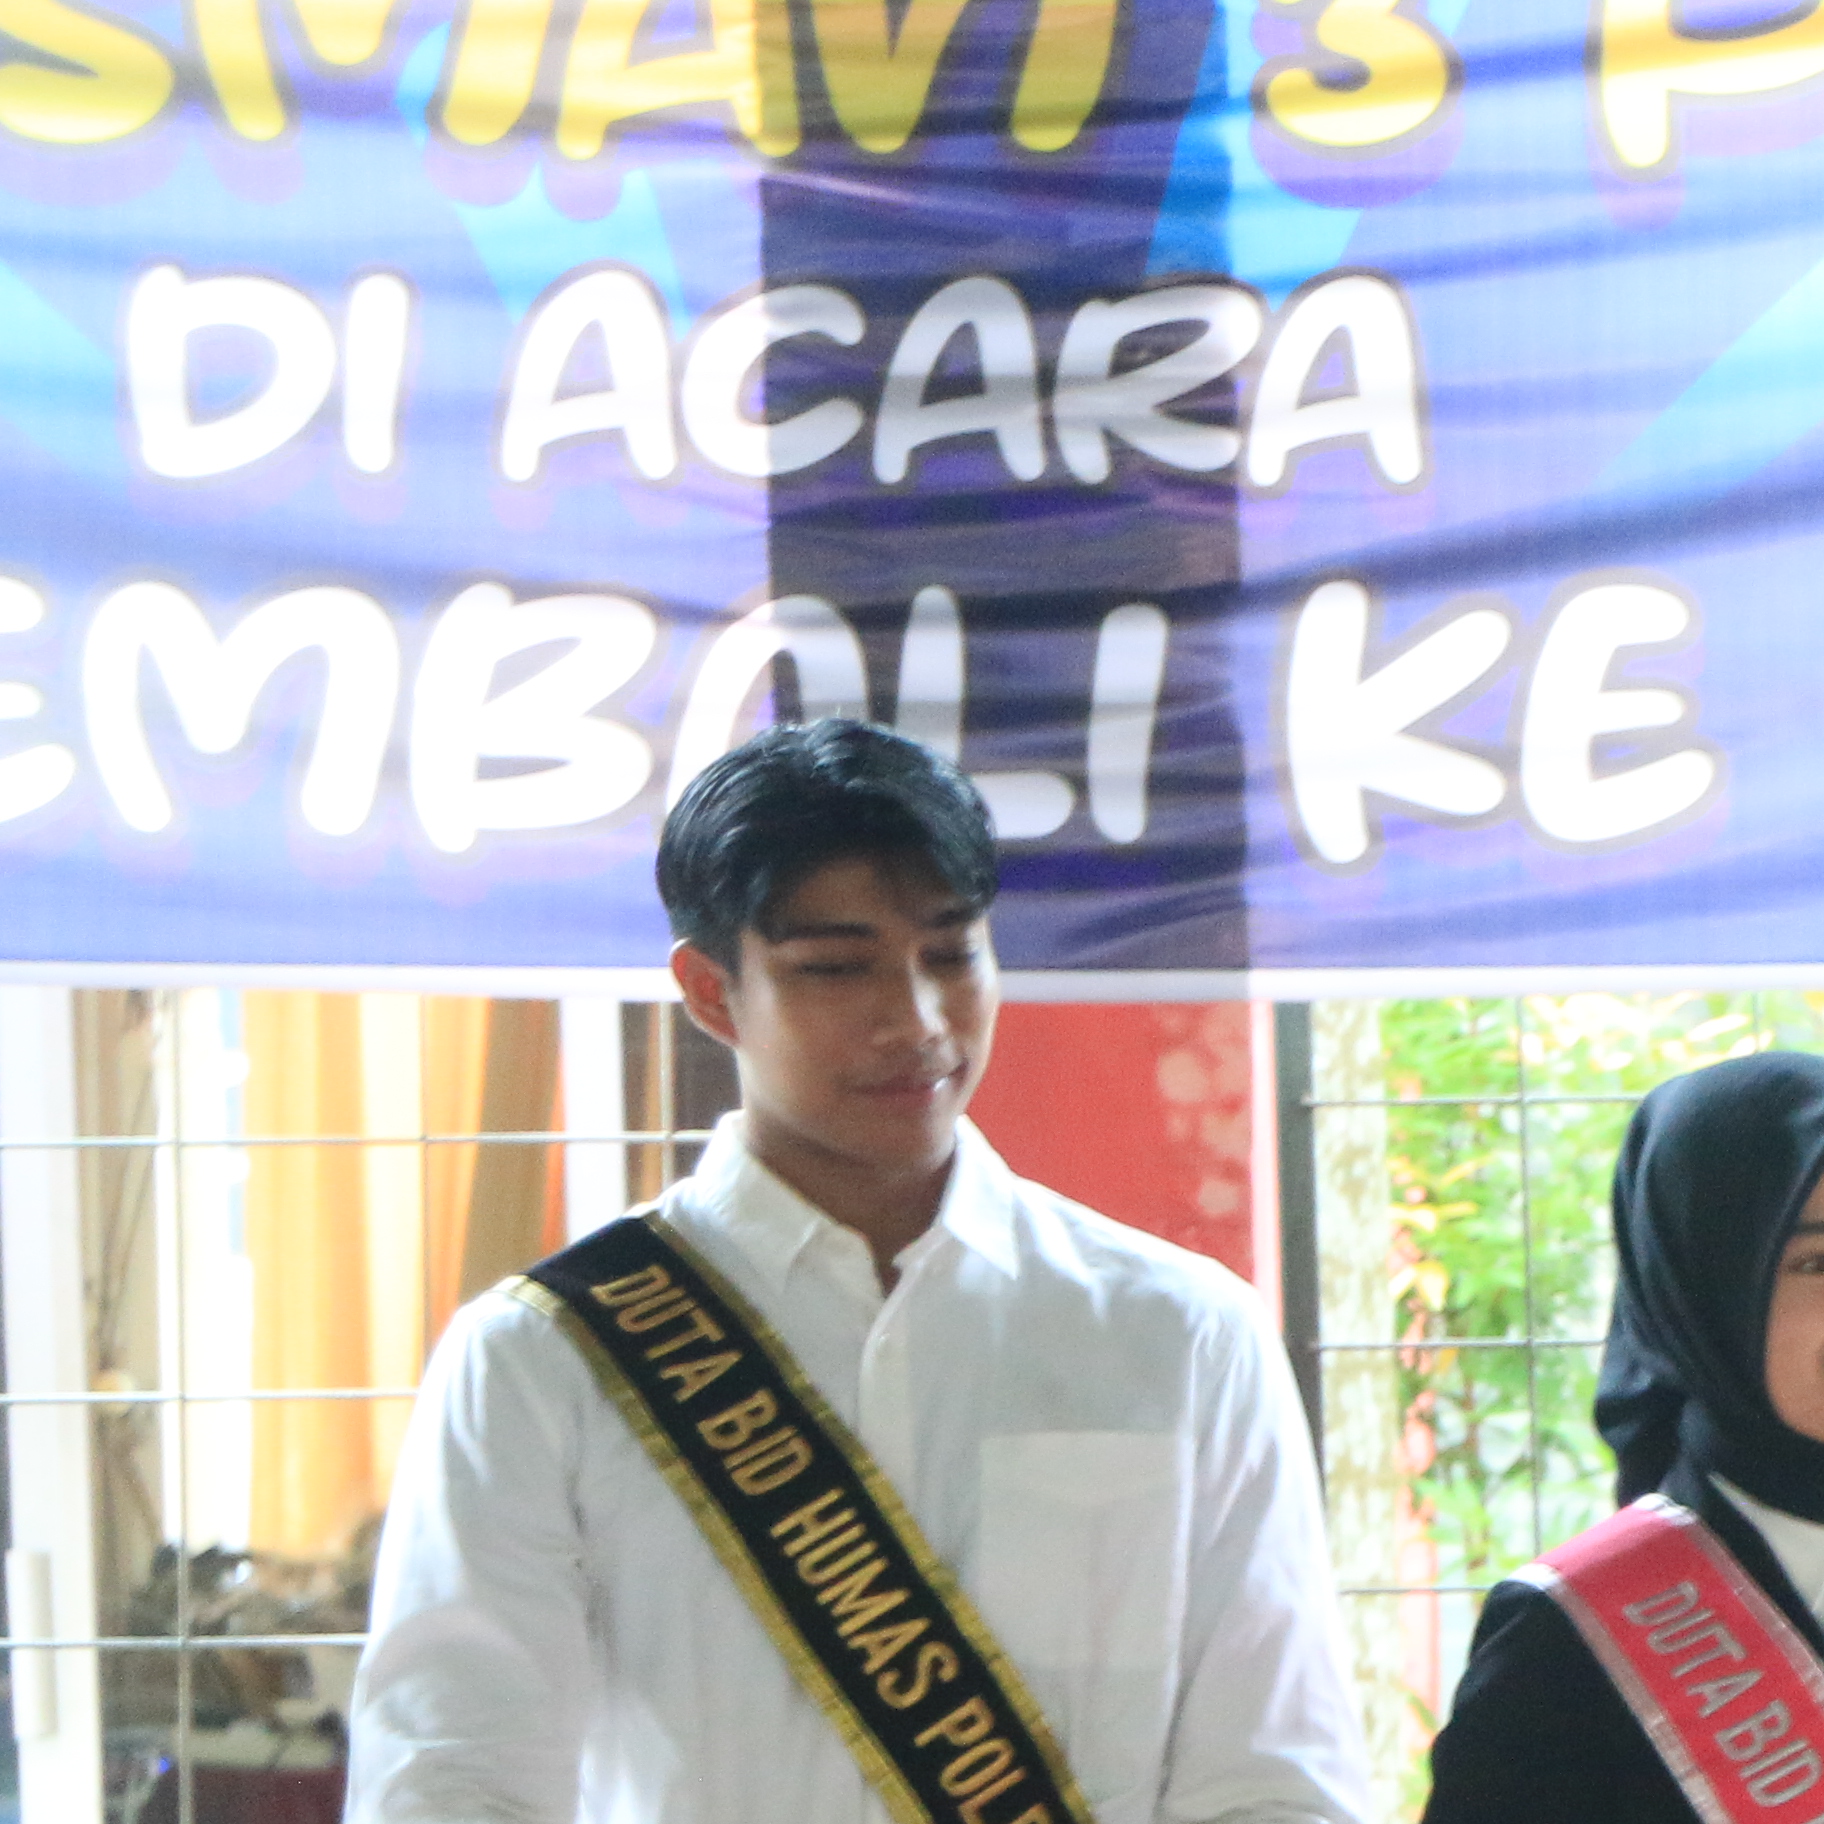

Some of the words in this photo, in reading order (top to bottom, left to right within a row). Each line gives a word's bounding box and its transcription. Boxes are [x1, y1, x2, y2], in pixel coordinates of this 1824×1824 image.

[128, 262, 410, 480] DI
[501, 263, 1427, 487] ACARA
[1289, 576, 1720, 866] KE
[592, 1262, 743, 1402] DUTA
[695, 1390, 817, 1495] BID
[769, 1488, 957, 1713] HUMAS
[1621, 1579, 1765, 1720] DUTA
[1715, 1703, 1823, 1811] BID
